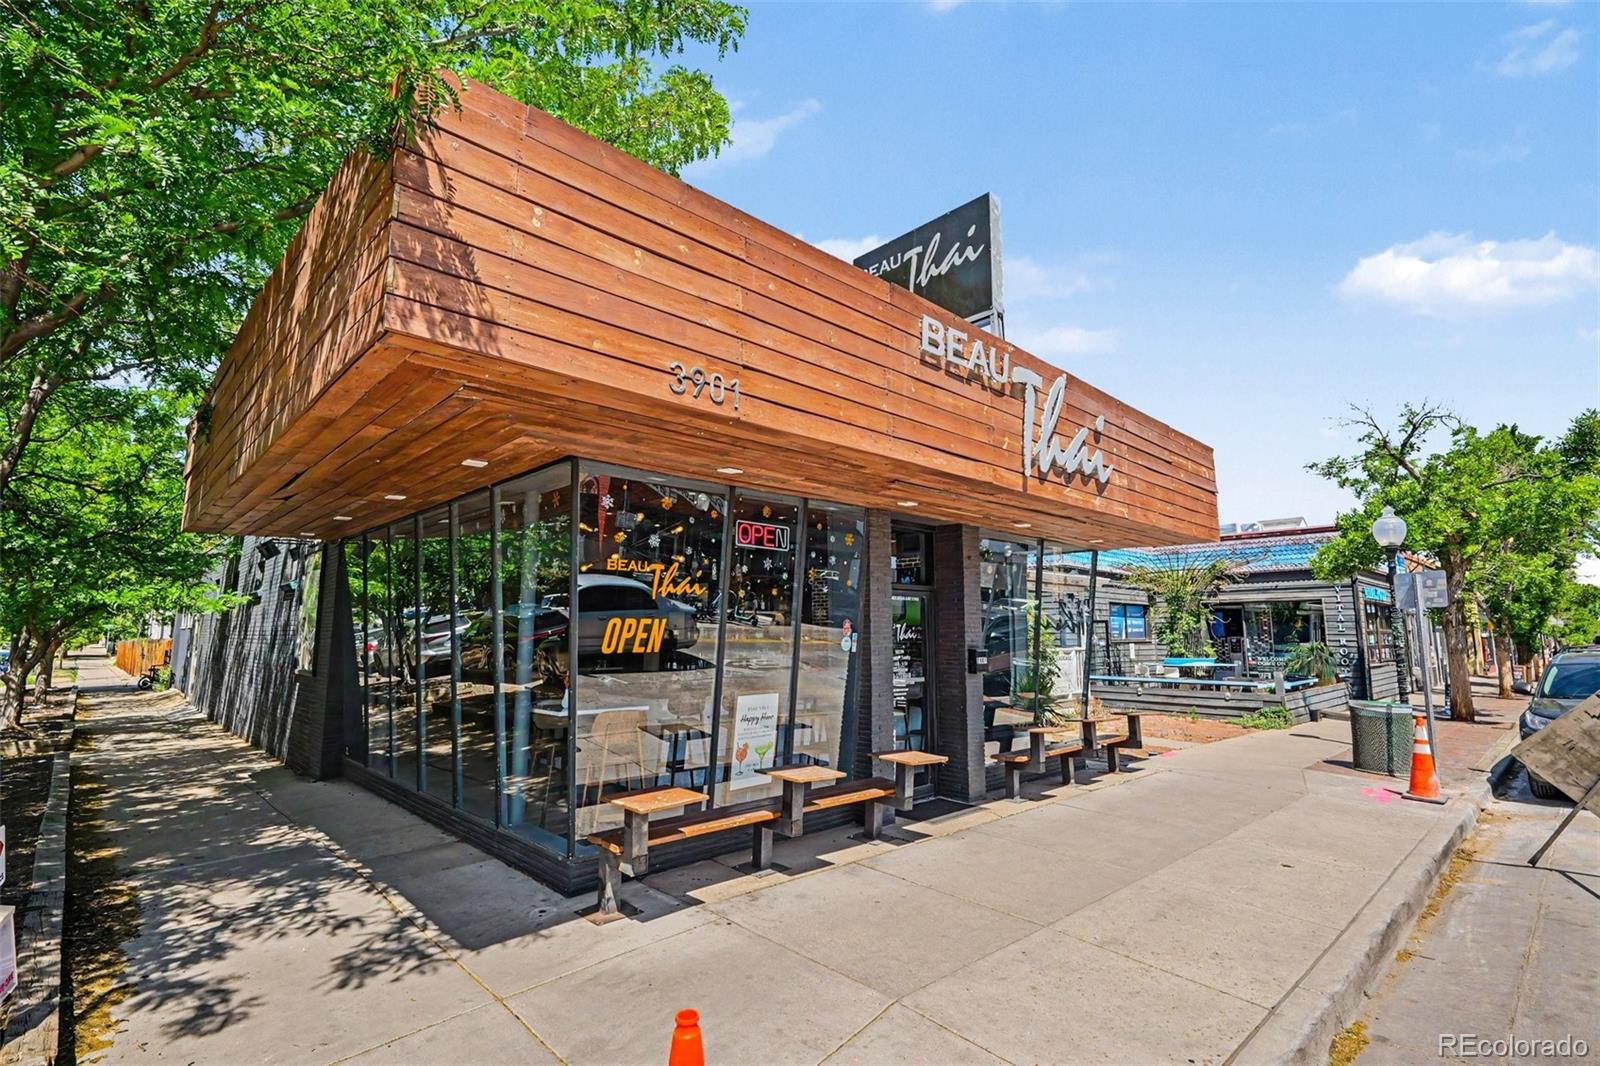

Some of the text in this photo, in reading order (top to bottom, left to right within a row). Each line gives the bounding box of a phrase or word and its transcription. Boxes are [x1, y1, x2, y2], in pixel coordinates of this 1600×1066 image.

[864, 224, 985, 292] EAU Thai
[669, 361, 740, 411] 3901
[921, 313, 1113, 484] BEAU Thai
[738, 523, 787, 549] OPEN
[606, 558, 708, 600] BEAU Thai
[1334, 584, 1346, 633] VITAL
[601, 617, 668, 655] OPEN
[740, 713, 760, 726] Happy
